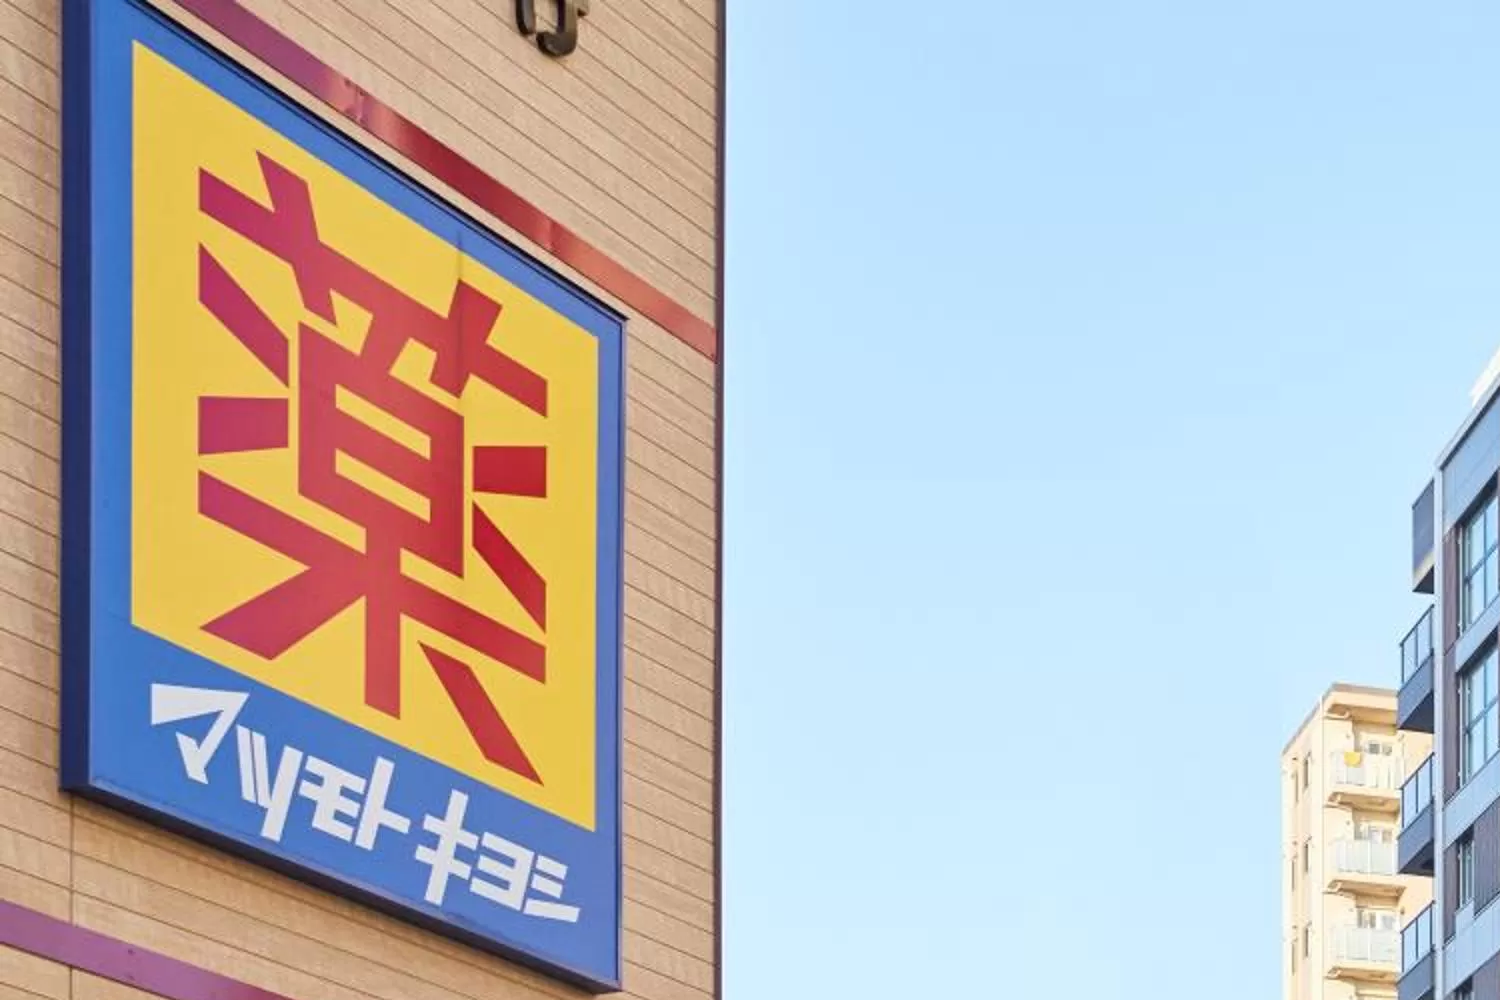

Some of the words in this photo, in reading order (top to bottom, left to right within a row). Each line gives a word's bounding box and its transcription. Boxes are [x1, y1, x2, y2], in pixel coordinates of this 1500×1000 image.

[150, 683, 582, 924] マツモトキヨシ
